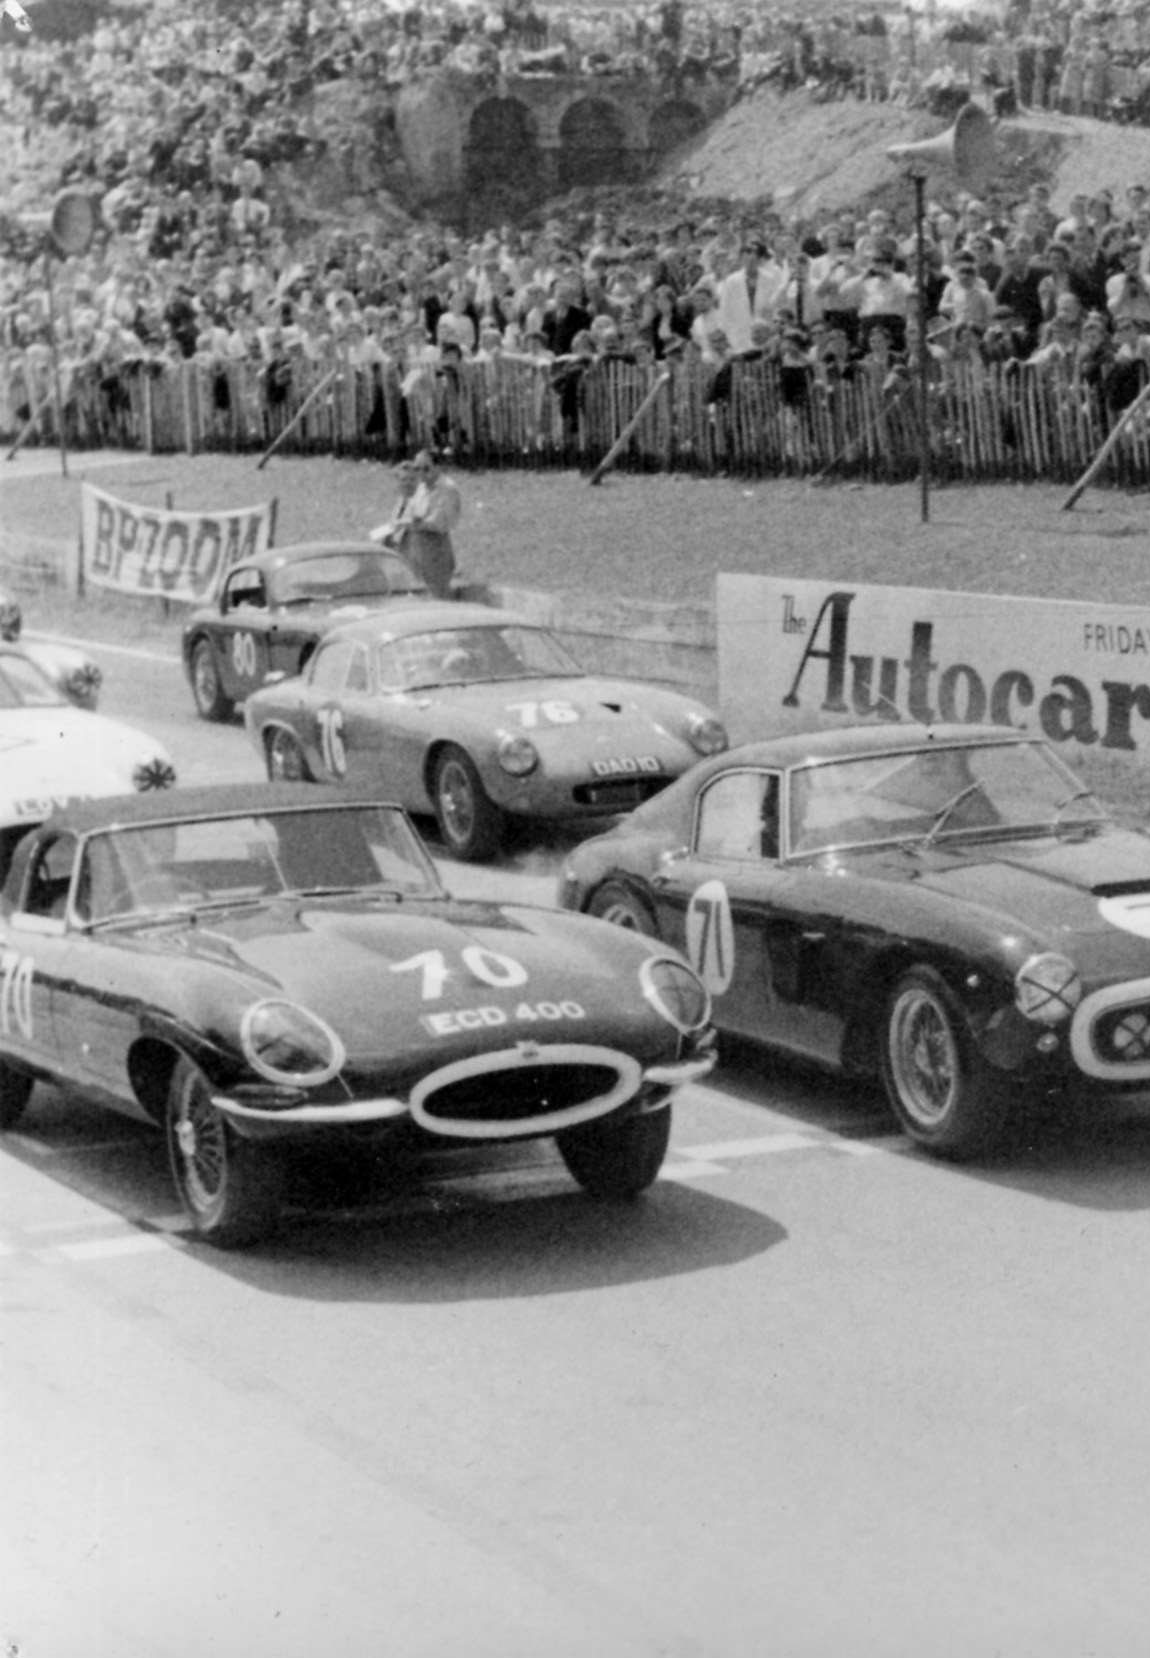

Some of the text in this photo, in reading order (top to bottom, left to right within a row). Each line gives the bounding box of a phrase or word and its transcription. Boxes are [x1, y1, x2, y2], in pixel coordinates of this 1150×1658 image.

[505, 700, 579, 727] 76
[317, 709, 347, 774] 76
[694, 899, 724, 979] 71
[388, 945, 529, 1000] 70
[428, 1000, 587, 1036] ECD 400
